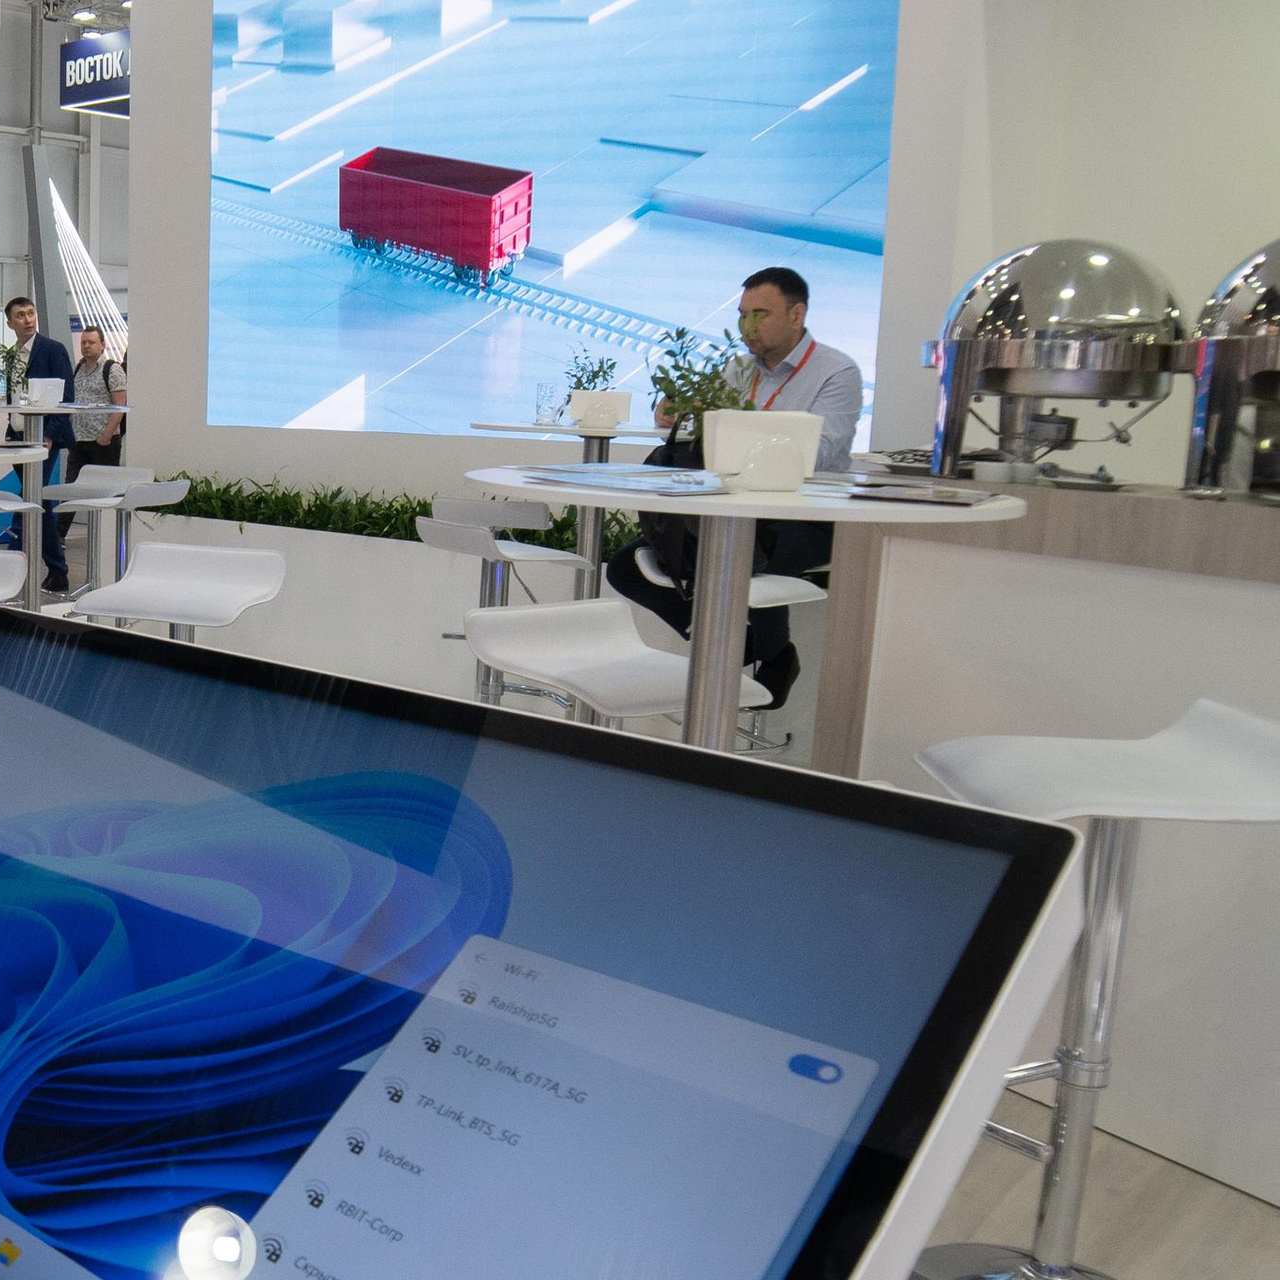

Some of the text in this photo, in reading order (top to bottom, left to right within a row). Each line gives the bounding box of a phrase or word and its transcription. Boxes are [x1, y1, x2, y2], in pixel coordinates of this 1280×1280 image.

[66, 50, 124, 87] ВОСТОК
[504, 962, 540, 982] Wi-Fi
[416, 1095, 520, 1147] TP-Link_BTS_5G
[335, 1199, 404, 1243] RBIT-Corp
